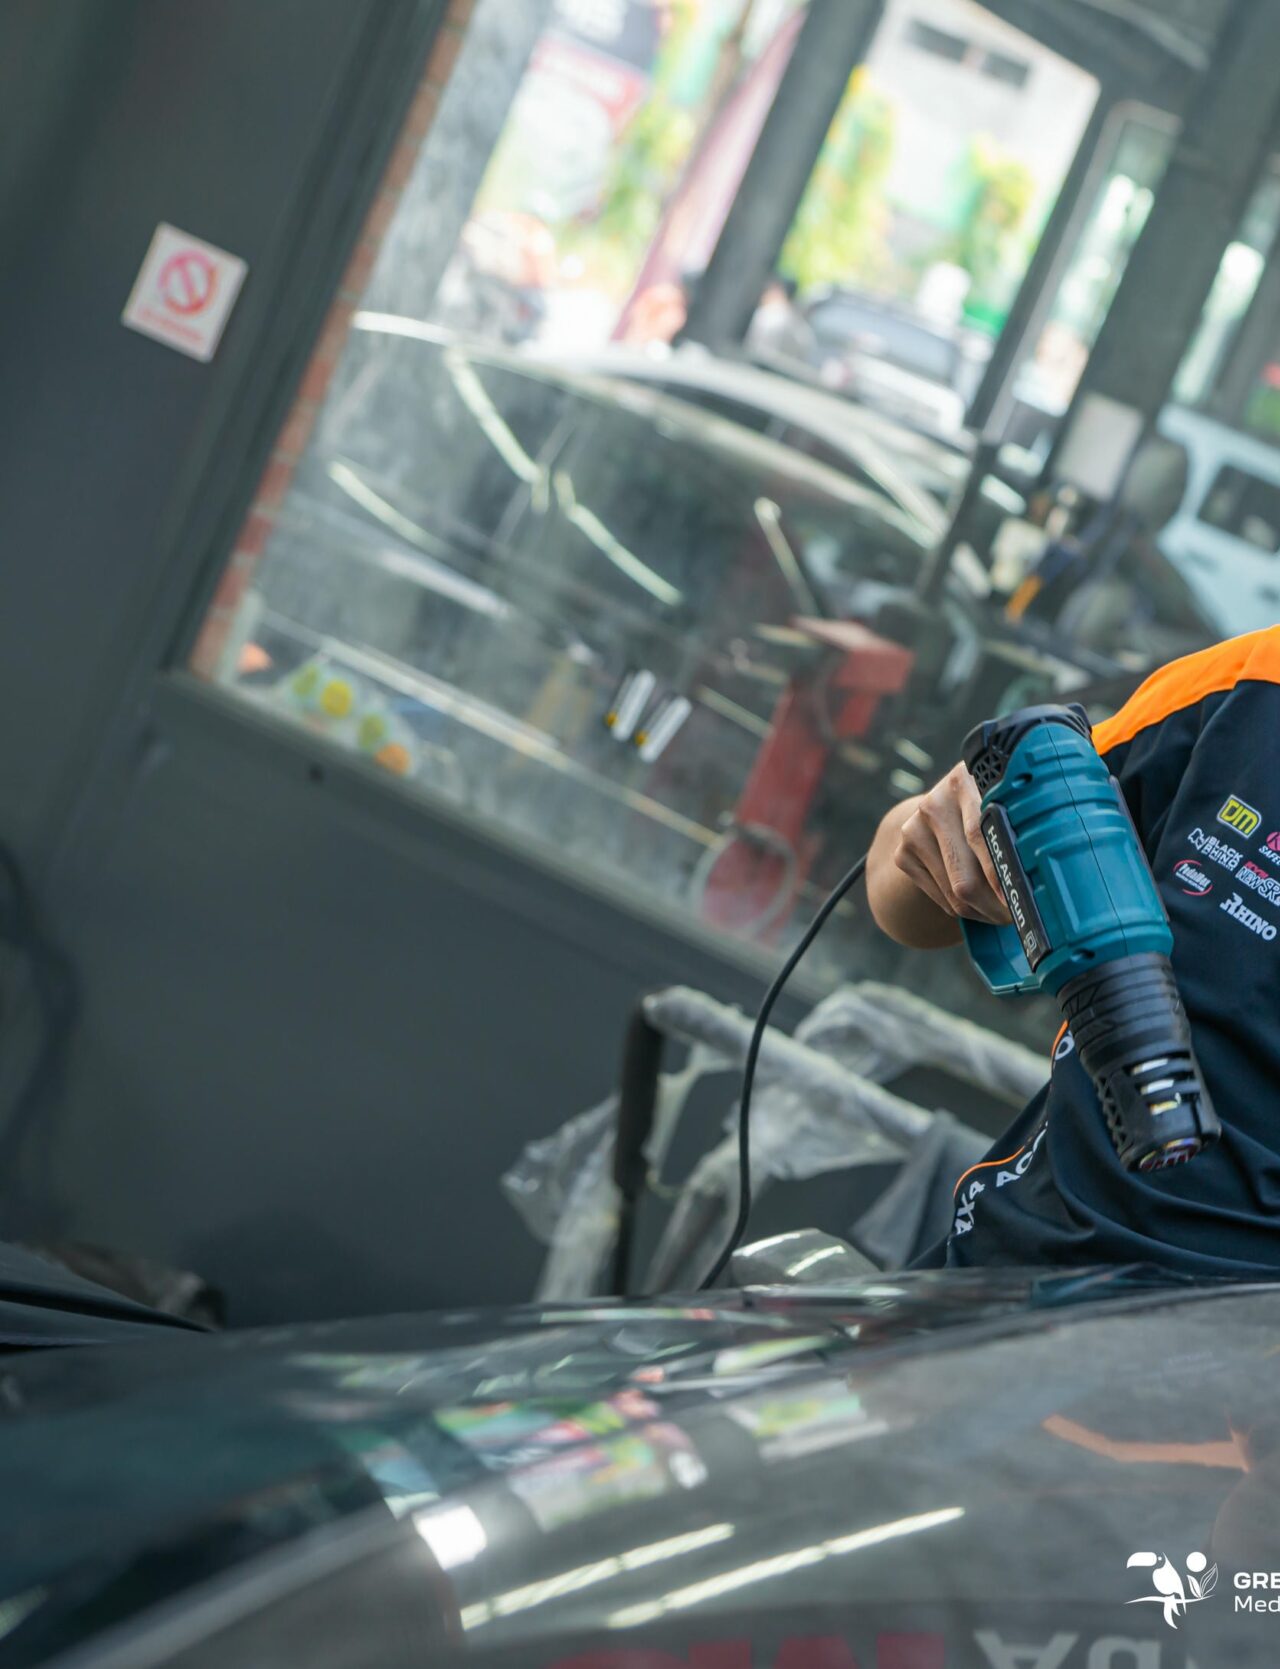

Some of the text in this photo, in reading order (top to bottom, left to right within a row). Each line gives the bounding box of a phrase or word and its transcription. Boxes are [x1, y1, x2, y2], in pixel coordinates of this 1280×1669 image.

[1203, 845, 1239, 870] RHINO
[1208, 836, 1244, 862] BLACK
[987, 825, 1003, 861] Hot
[1000, 863, 1013, 887] Air
[1010, 890, 1026, 928] Gun
[1219, 892, 1278, 941] RHINO
